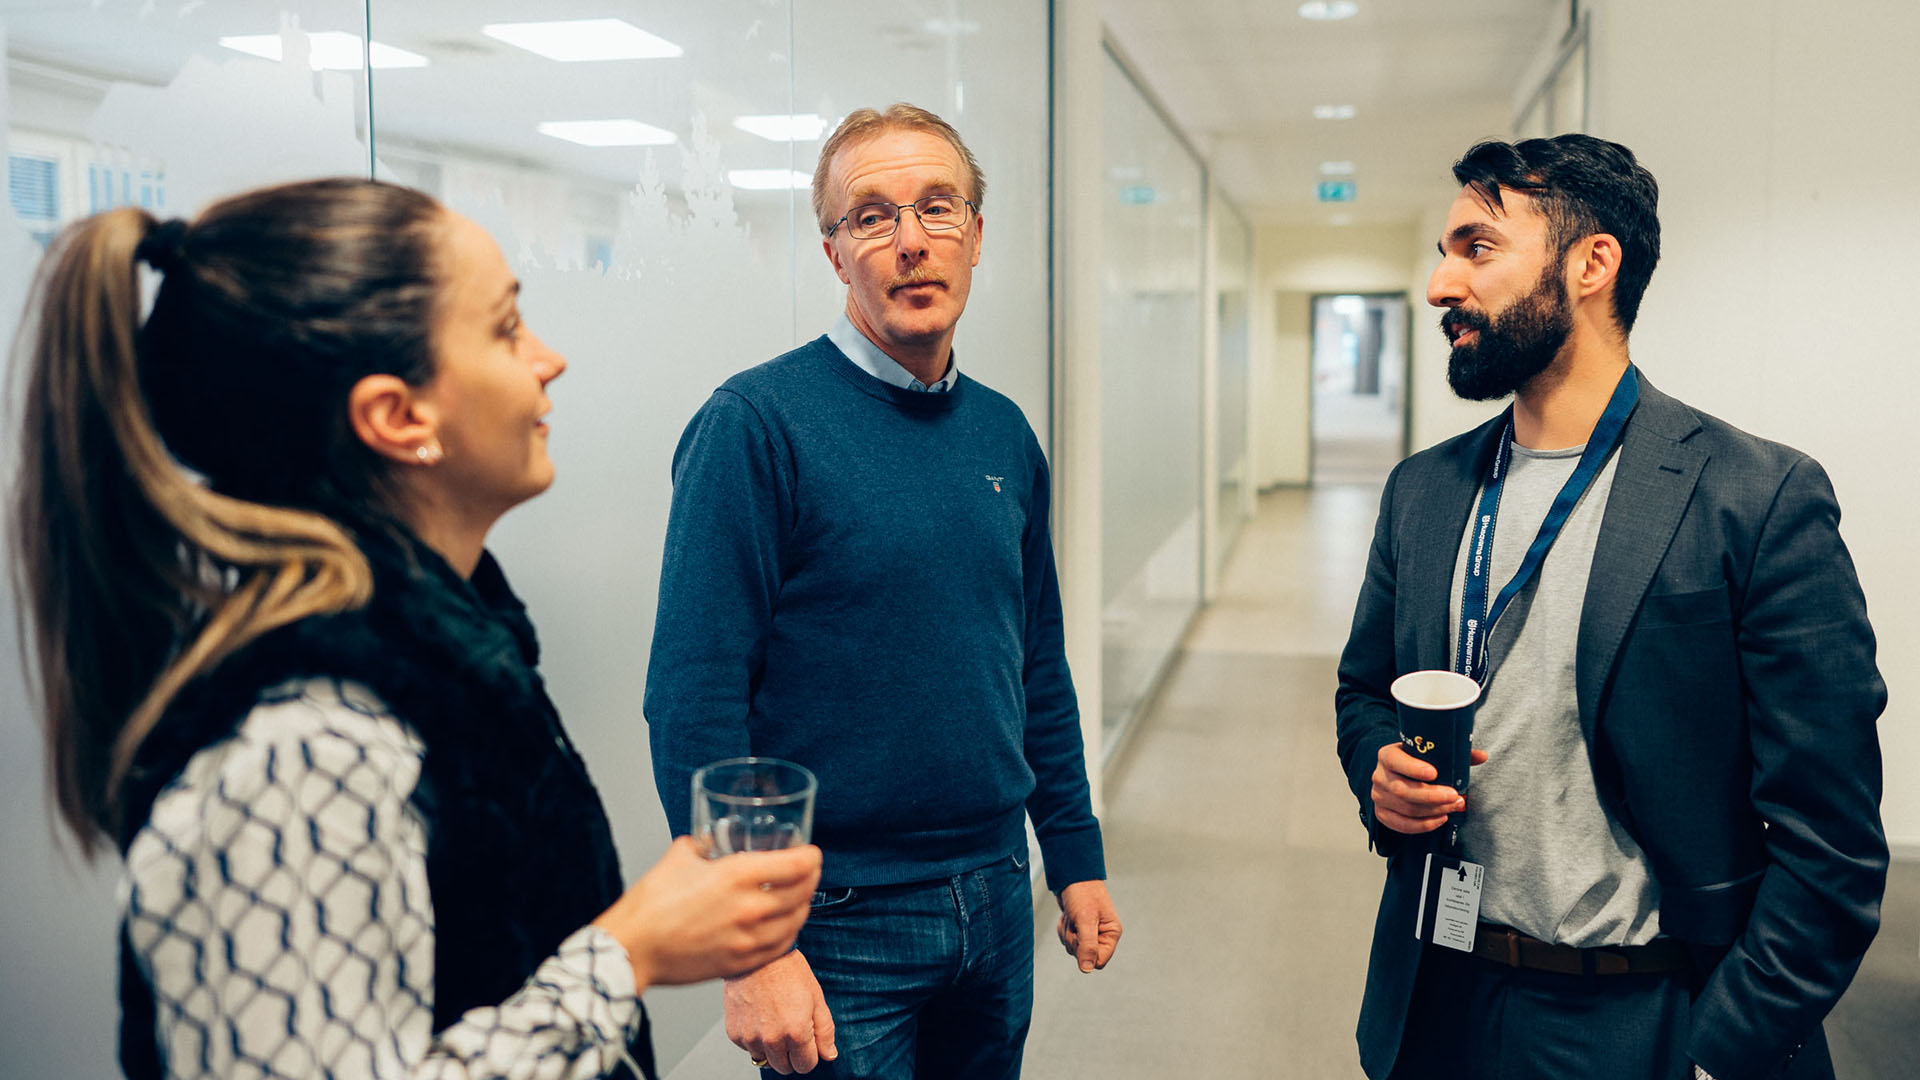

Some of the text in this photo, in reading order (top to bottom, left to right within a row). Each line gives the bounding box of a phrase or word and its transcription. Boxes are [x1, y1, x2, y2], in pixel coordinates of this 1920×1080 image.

[1493, 459, 1501, 479] Group
[1473, 522, 1489, 577] Husqvarna Group
[1466, 628, 1476, 665] Husqvarna
